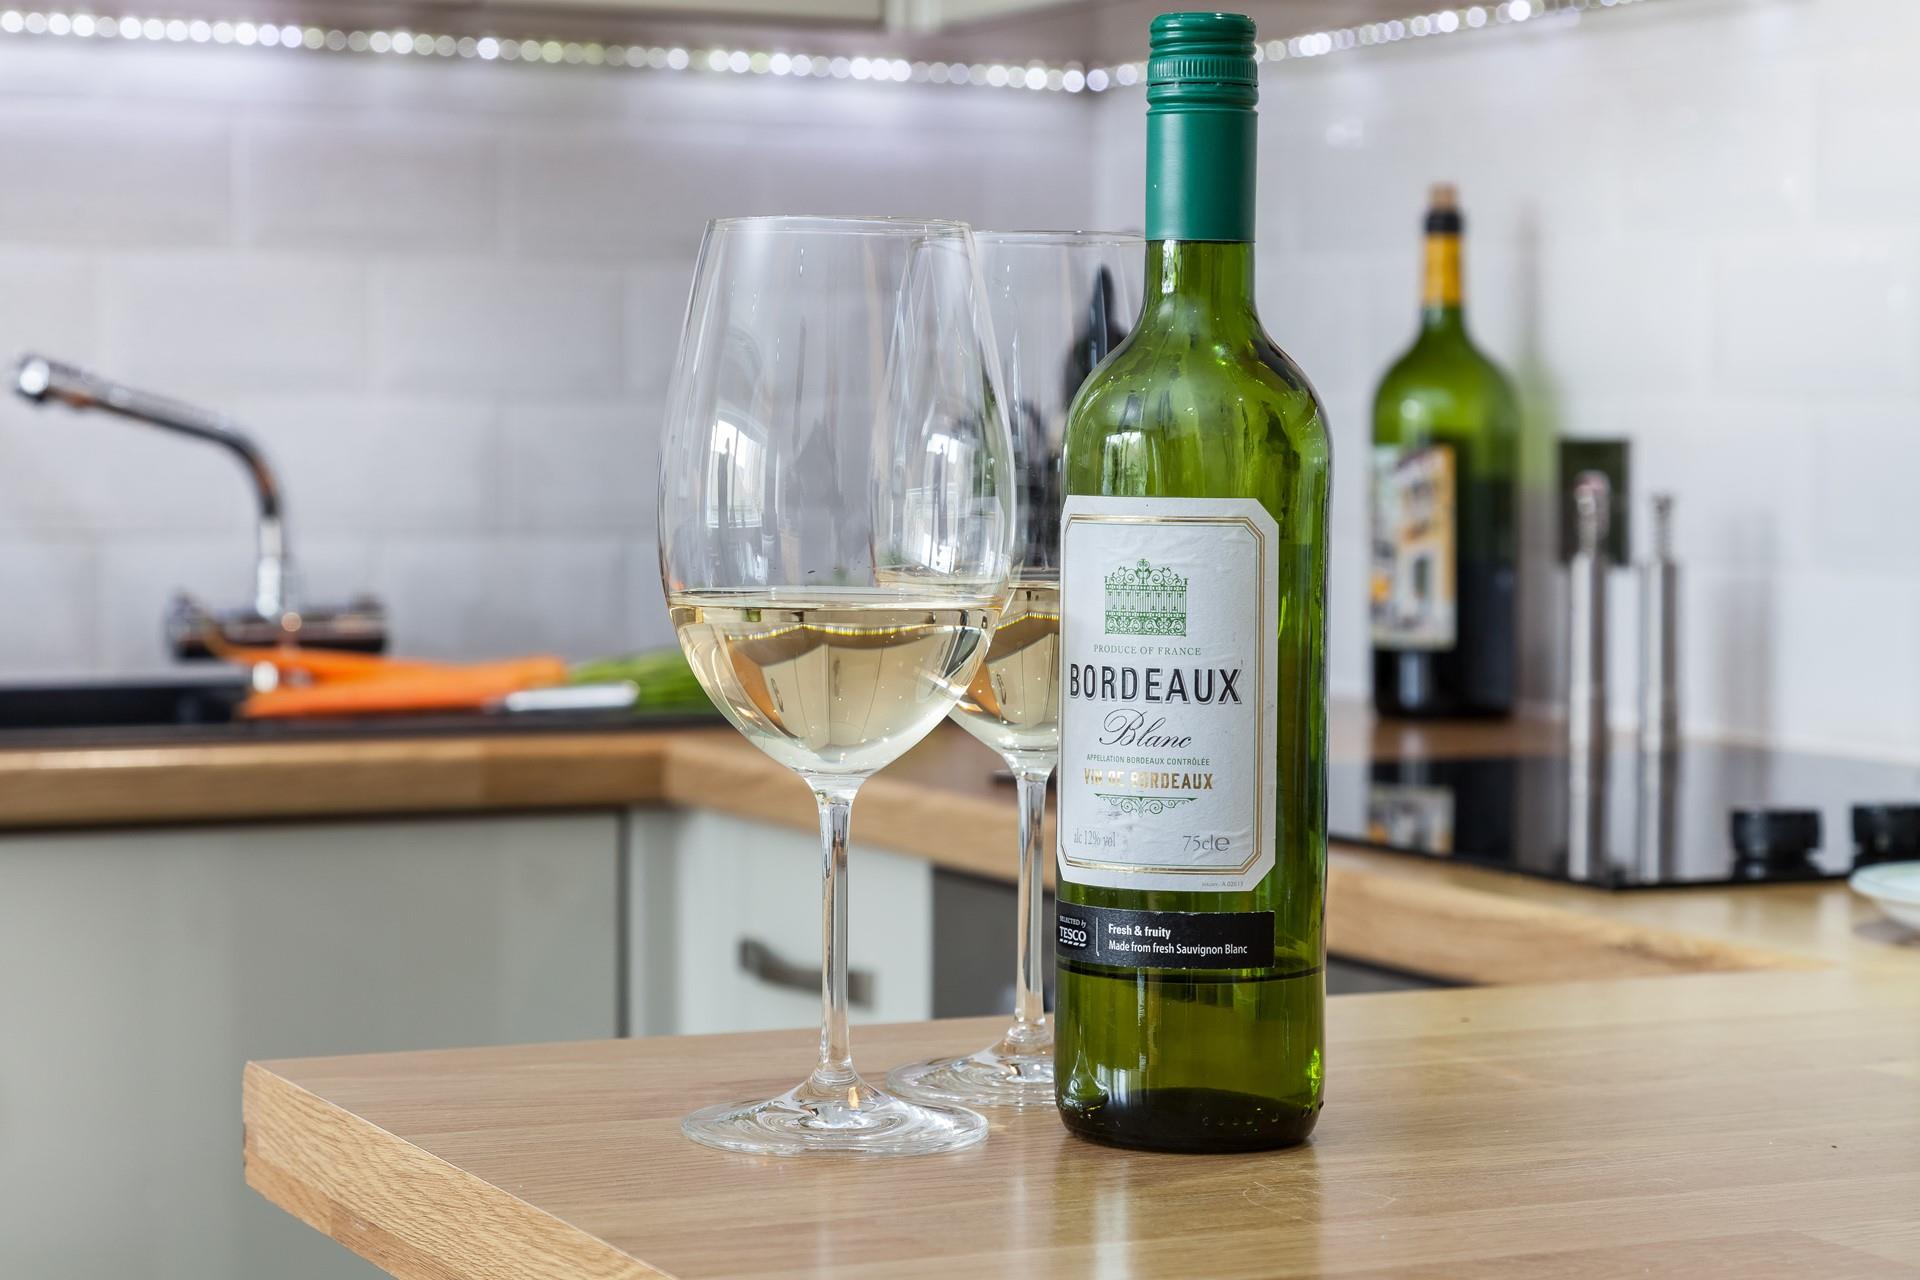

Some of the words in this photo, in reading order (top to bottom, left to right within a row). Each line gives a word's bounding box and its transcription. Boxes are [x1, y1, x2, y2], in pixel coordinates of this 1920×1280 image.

[1094, 644, 1136, 655] PRODUCE
[1140, 646, 1153, 655] OF
[1158, 646, 1201, 656] FRANCE
[1070, 664, 1242, 705] BORDEAUX
[1099, 709, 1192, 748] Blanc
[1087, 754, 1124, 763] APPELLATION
[1127, 757, 1165, 765] BORDEAUX
[1084, 768, 1103, 785] VIN
[1131, 772, 1214, 790] BORDEAUX
[1084, 830, 1100, 845] 12%
[1060, 916, 1080, 925] SELECTED
[1081, 920, 1087, 928] by
[1060, 926, 1087, 942] TESCO
[1108, 923, 1132, 935] Fresh
[1134, 925, 1142, 936] &
[1144, 926, 1171, 939] fruity
[1108, 939, 1129, 951] Made
[1131, 942, 1151, 953] from
[1152, 943, 1174, 954] fresh
[1176, 944, 1223, 957] Sauvignon
[1225, 944, 1248, 954] Blanc
